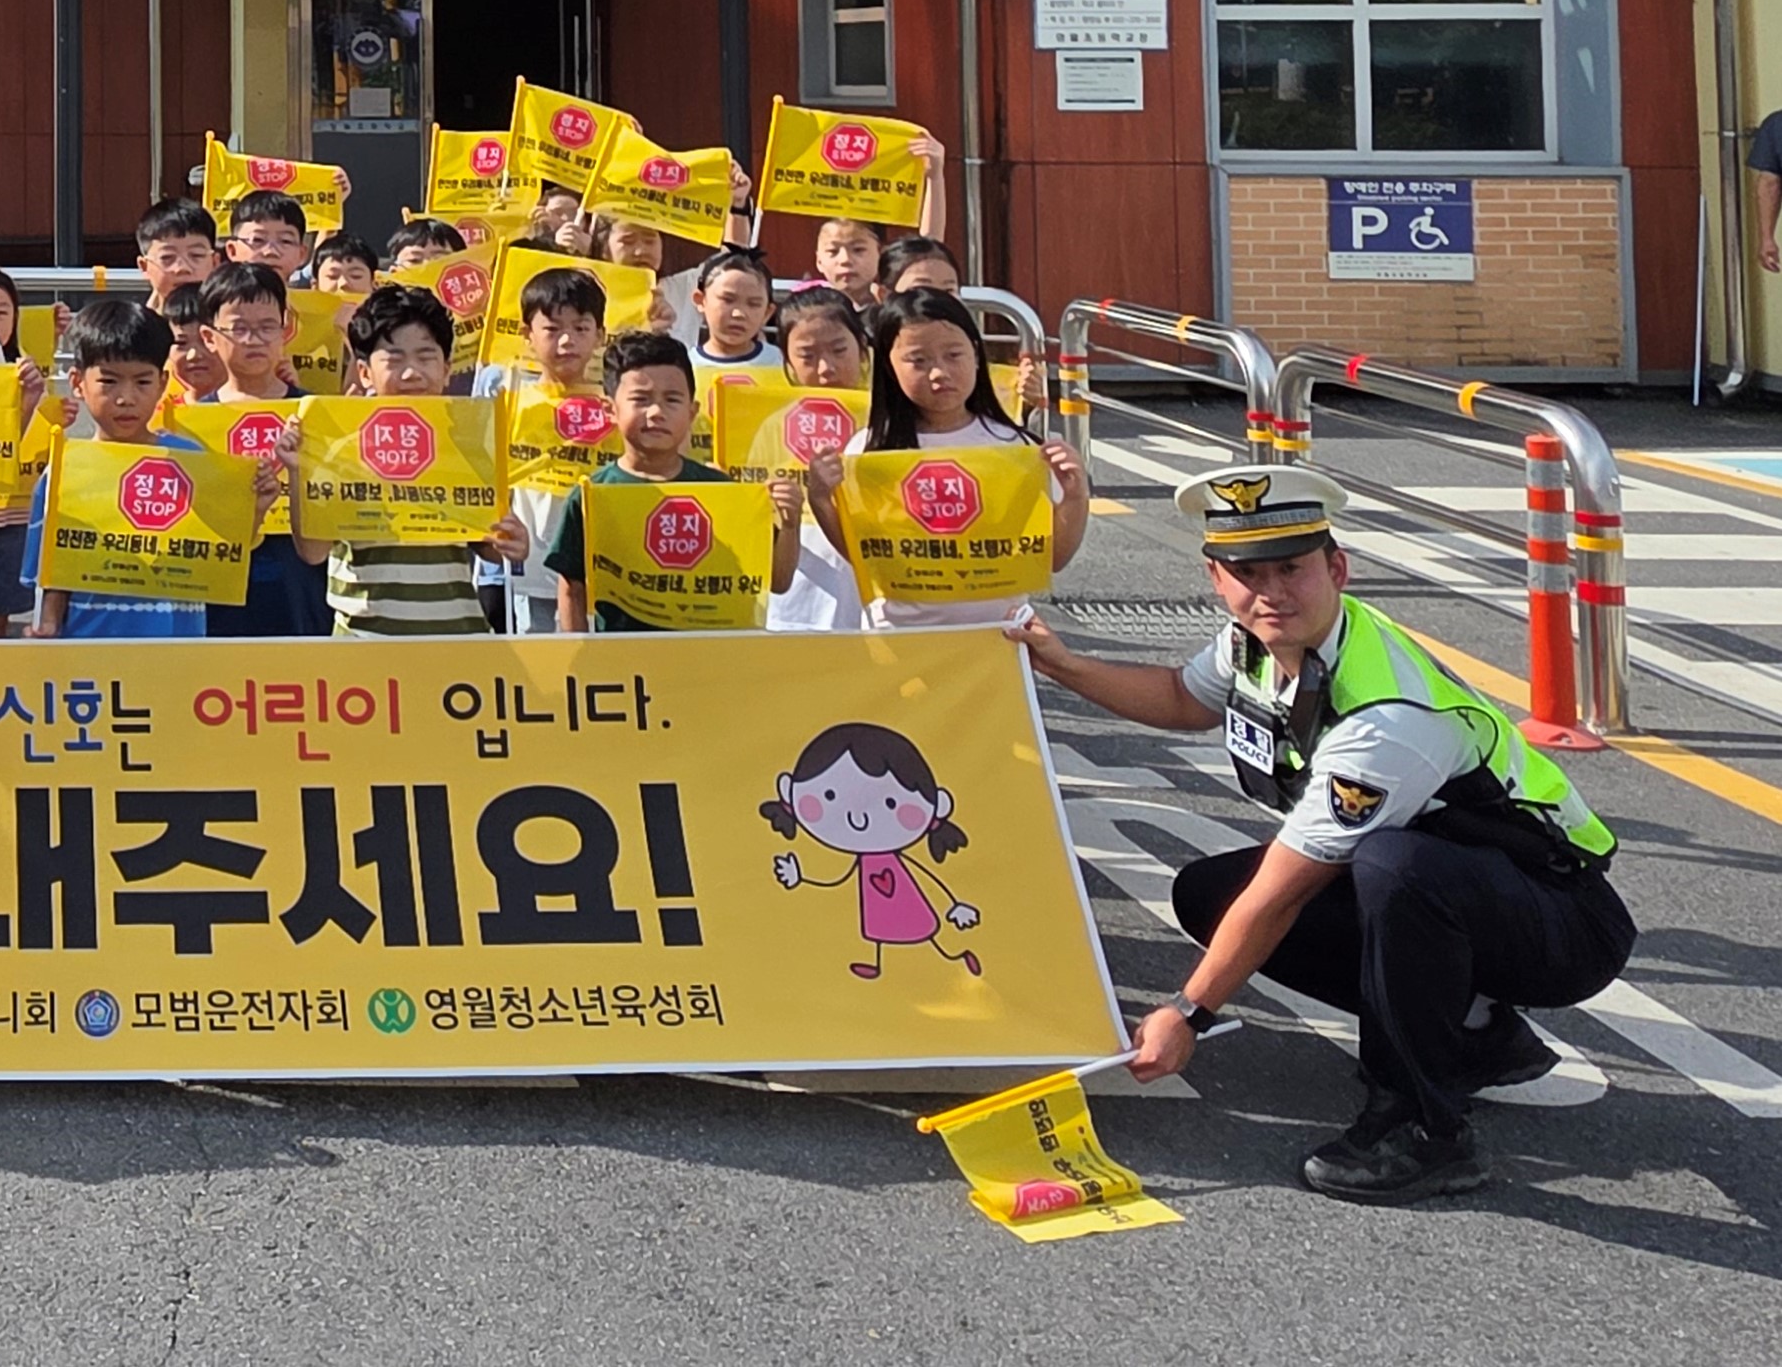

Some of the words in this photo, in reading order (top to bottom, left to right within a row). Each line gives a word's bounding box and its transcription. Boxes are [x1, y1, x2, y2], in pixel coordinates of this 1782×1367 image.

[833, 133, 869, 149] 정지
[831, 149, 866, 161] STOP
[1351, 206, 1389, 249] P
[445, 271, 480, 293] 정지
[454, 288, 483, 307] STOP
[798, 412, 841, 436] 정지
[240, 426, 281, 448] 정지
[134, 474, 180, 501] 정지
[917, 477, 966, 501] 정지
[132, 499, 177, 517] STOP
[920, 501, 968, 519] STOP
[659, 513, 700, 537] 정지
[56, 527, 97, 550] 안전한
[101, 532, 161, 558] 우리동네,
[168, 538, 210, 559] 보행자
[214, 540, 243, 563] 우선
[658, 538, 700, 554] STOP
[900, 538, 964, 560] 우리동네,
[969, 538, 1013, 558] 보행자
[1018, 535, 1045, 555] 우선
[627, 574, 688, 594] 우리동네,
[693, 575, 733, 595] 보행자
[738, 575, 763, 594] 우선
[193, 677, 403, 761] 어린이
[442, 675, 673, 759] 입니다.
[1231, 737, 1269, 766] POLICE
[131, 989, 350, 1032] 모범운전자회
[423, 983, 725, 1031] 영월청소년육성회
